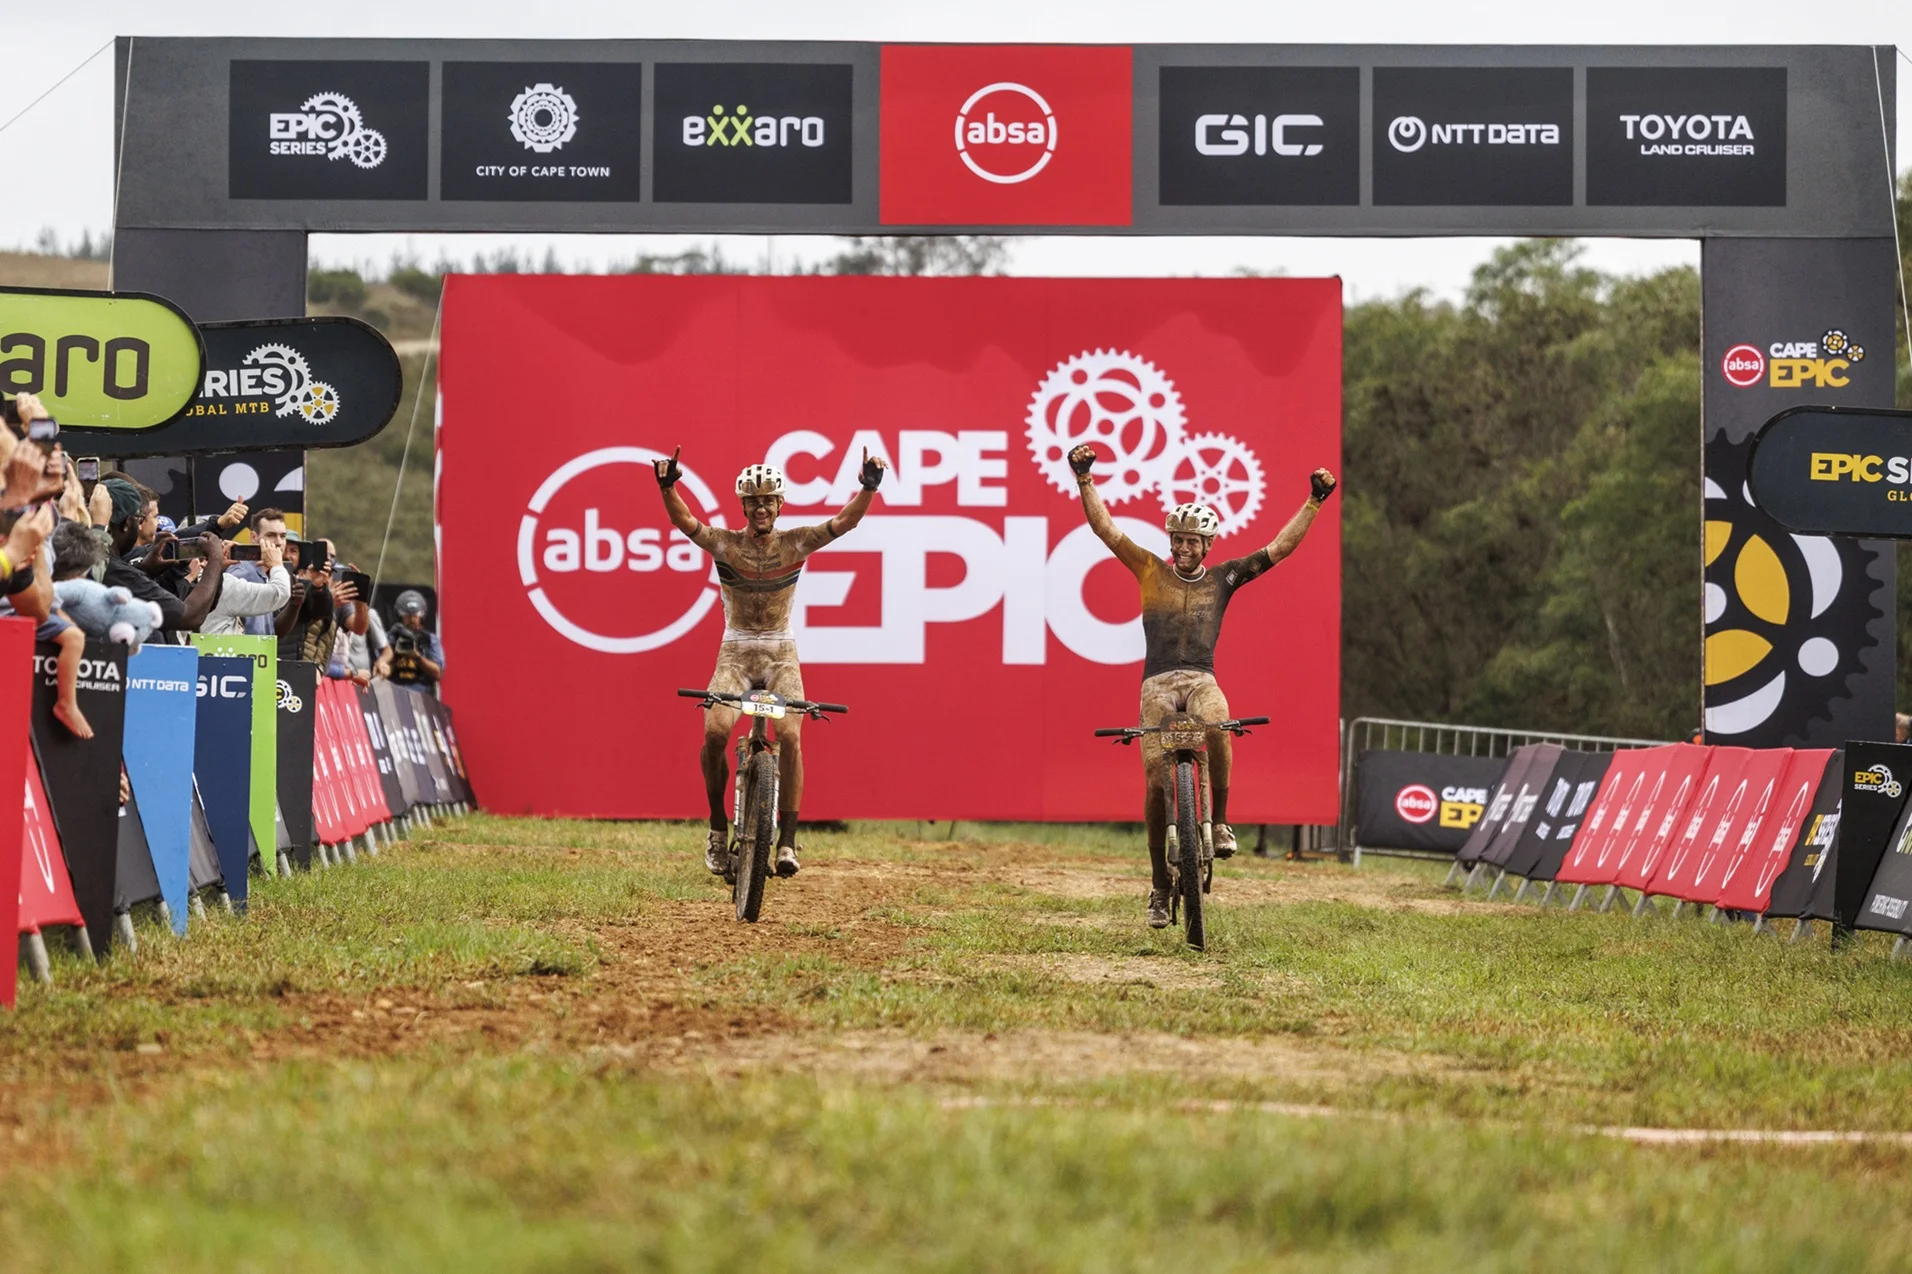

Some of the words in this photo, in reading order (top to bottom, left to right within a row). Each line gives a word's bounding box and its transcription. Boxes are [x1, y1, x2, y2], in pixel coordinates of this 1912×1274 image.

[270, 113, 337, 139] EPIC
[683, 104, 824, 147] exxaro
[967, 112, 1045, 144] absa
[1195, 113, 1324, 156] GIC
[1432, 124, 1485, 144] NTT
[1620, 114, 1754, 139] TOYOTA
[269, 141, 327, 154] SERIES
[1641, 144, 1683, 155] LAND
[1684, 144, 1754, 155] CRUISER
[476, 165, 505, 176] CITY
[509, 165, 527, 176] OF
[531, 166, 566, 177] CAPE
[569, 166, 610, 177] TOWN
[1770, 342, 1817, 358] CAPE
[1728, 357, 1759, 371] absa
[1770, 358, 1850, 387] EPIC
[199, 367, 285, 398] RIES
[235, 402, 269, 414] MTB
[764, 430, 1008, 506] CAPE
[1810, 452, 1884, 483] EPIC
[1886, 456, 1912, 485] S
[1887, 490, 1912, 502] GL
[543, 508, 704, 572] absa
[32, 655, 120, 681] TOOTA
[131, 679, 157, 691] NTT
[753, 703, 774, 713] 15-1
[1855, 772, 1882, 784] EPIC
[1401, 794, 1432, 809] absa
[1441, 786, 1488, 804] CAPE
